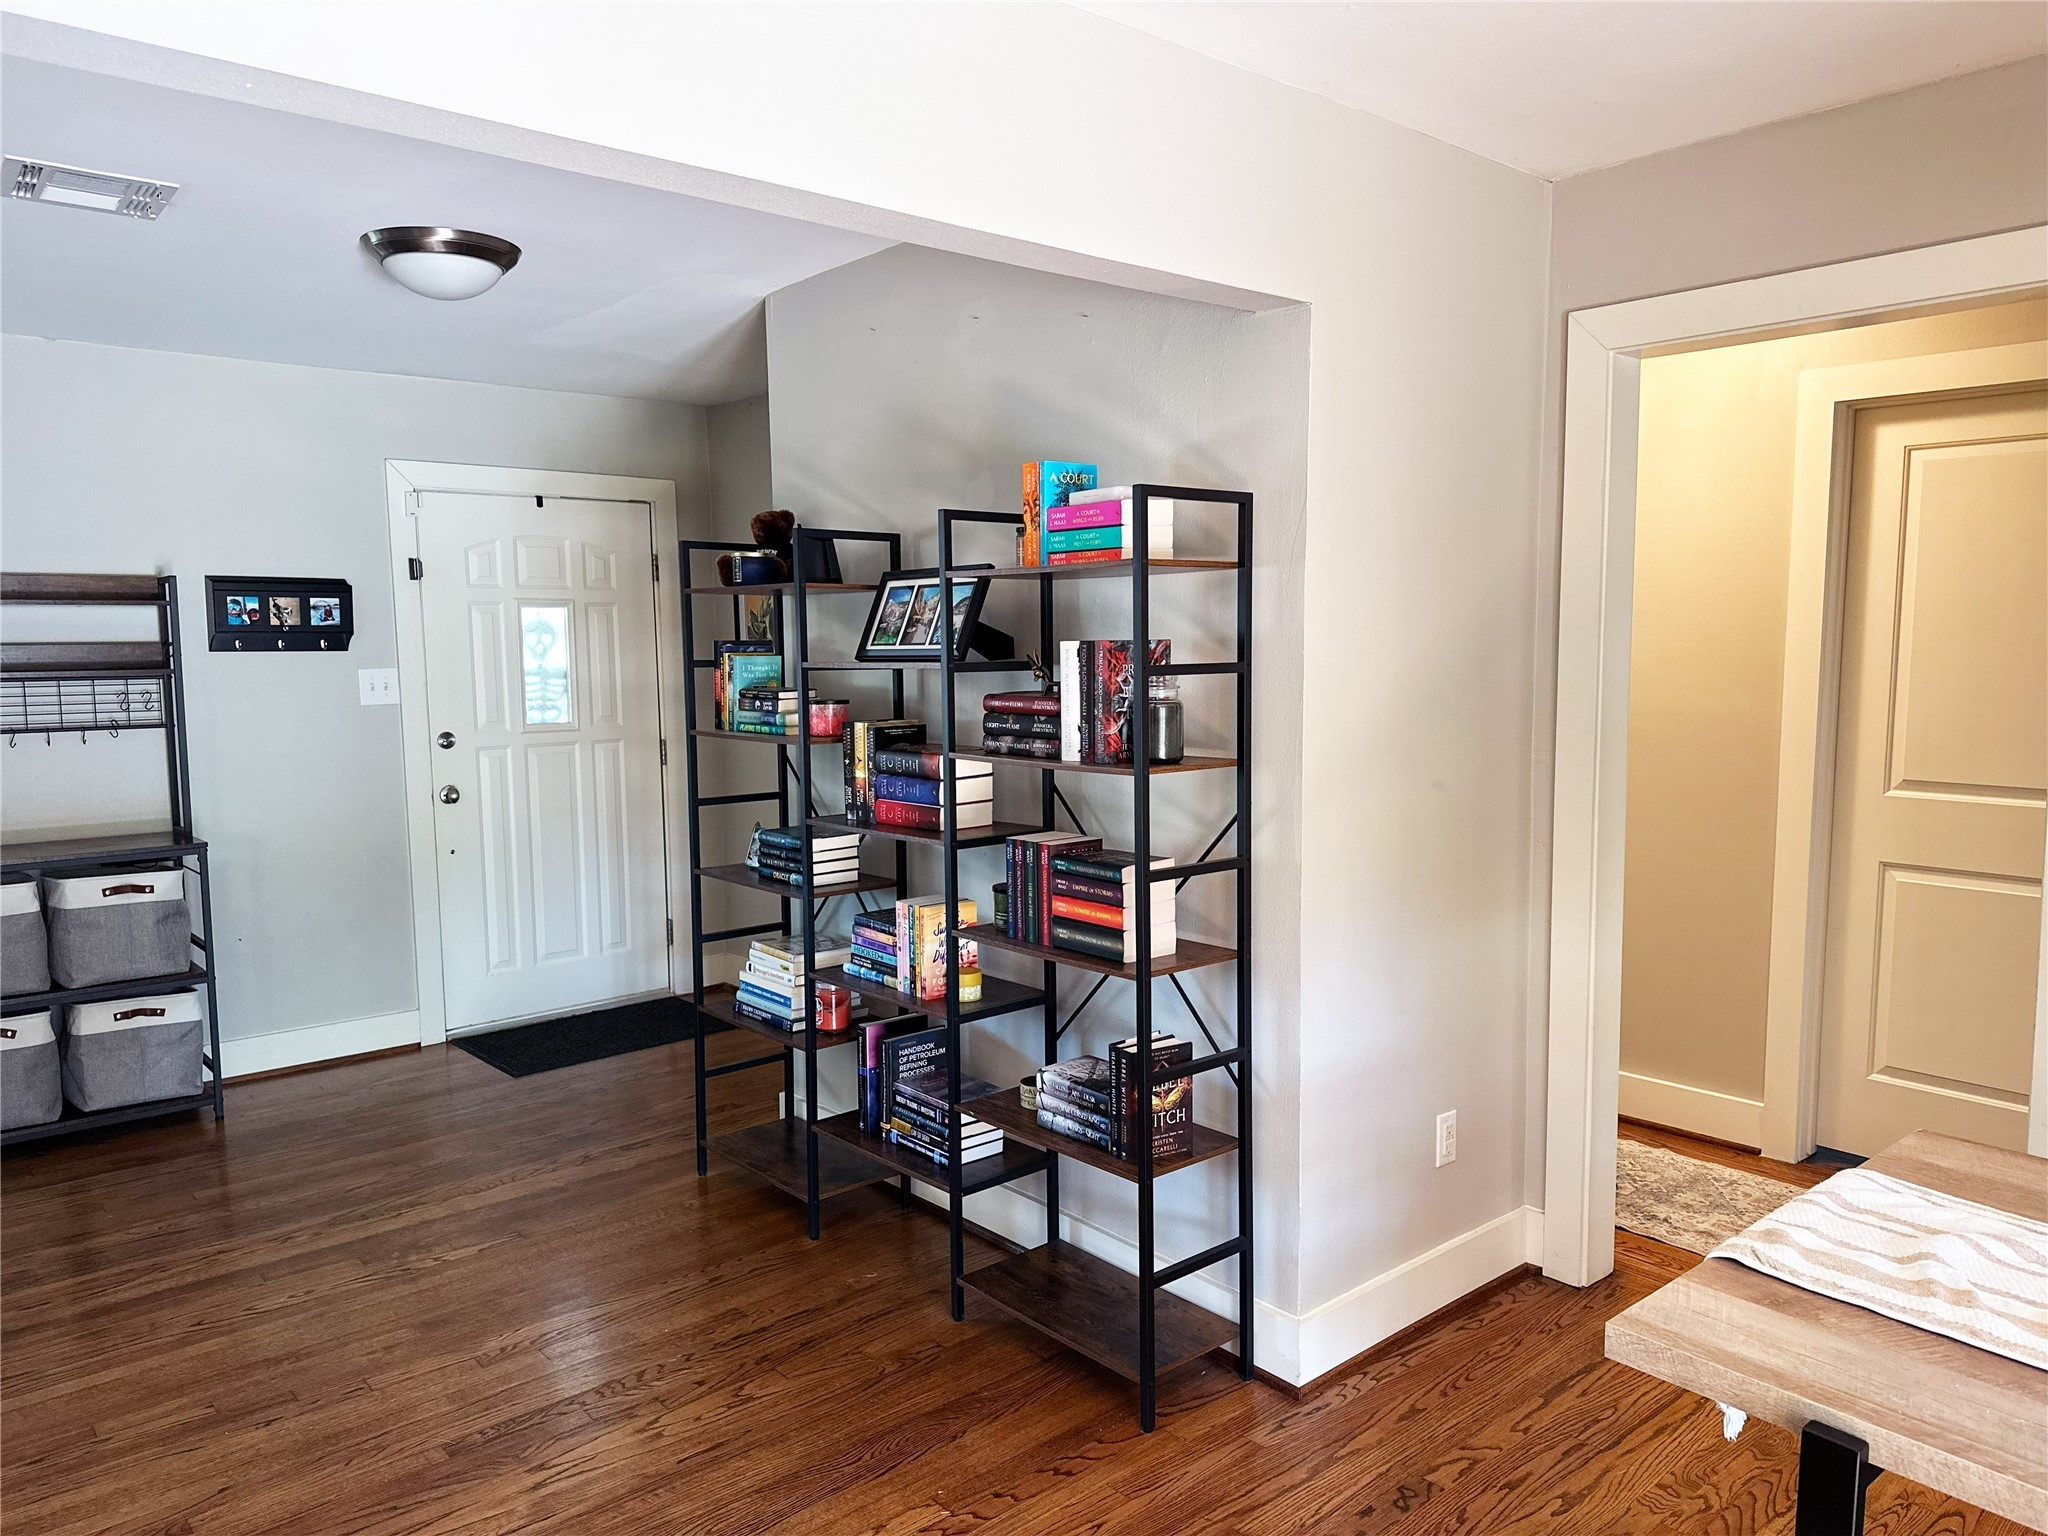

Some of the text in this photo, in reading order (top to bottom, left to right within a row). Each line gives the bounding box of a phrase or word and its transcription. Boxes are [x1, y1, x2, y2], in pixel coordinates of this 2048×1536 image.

[1050, 473, 1094, 485] A COURT
[740, 724, 755, 732] PLAYING
[773, 871, 789, 881] ORACLE
[1072, 884, 1088, 892] EMPIRE
[1094, 888, 1114, 897] STORMS
[1074, 907, 1090, 915] TOWER
[1075, 934, 1097, 944] KINGDOM
[853, 946, 880, 960] HOOKED
[754, 1009, 771, 1020] UNIVERSITY
[898, 1042, 936, 1057] HANDBOOK
[898, 1047, 946, 1064] OF PETROLEUM
[899, 1060, 928, 1072] REFINING
[899, 1065, 936, 1079] PROCESSES
[896, 1094, 906, 1104] ENERGY
[906, 1100, 918, 1110] TRADING
[921, 1106, 935, 1118] INVESTING
[1070, 1097, 1094, 1108] BROADBENT
[898, 1107, 917, 1118] QUESTION
[1152, 1108, 1186, 1129] ITCH
[1152, 1143, 1178, 1154] CCARELLI
